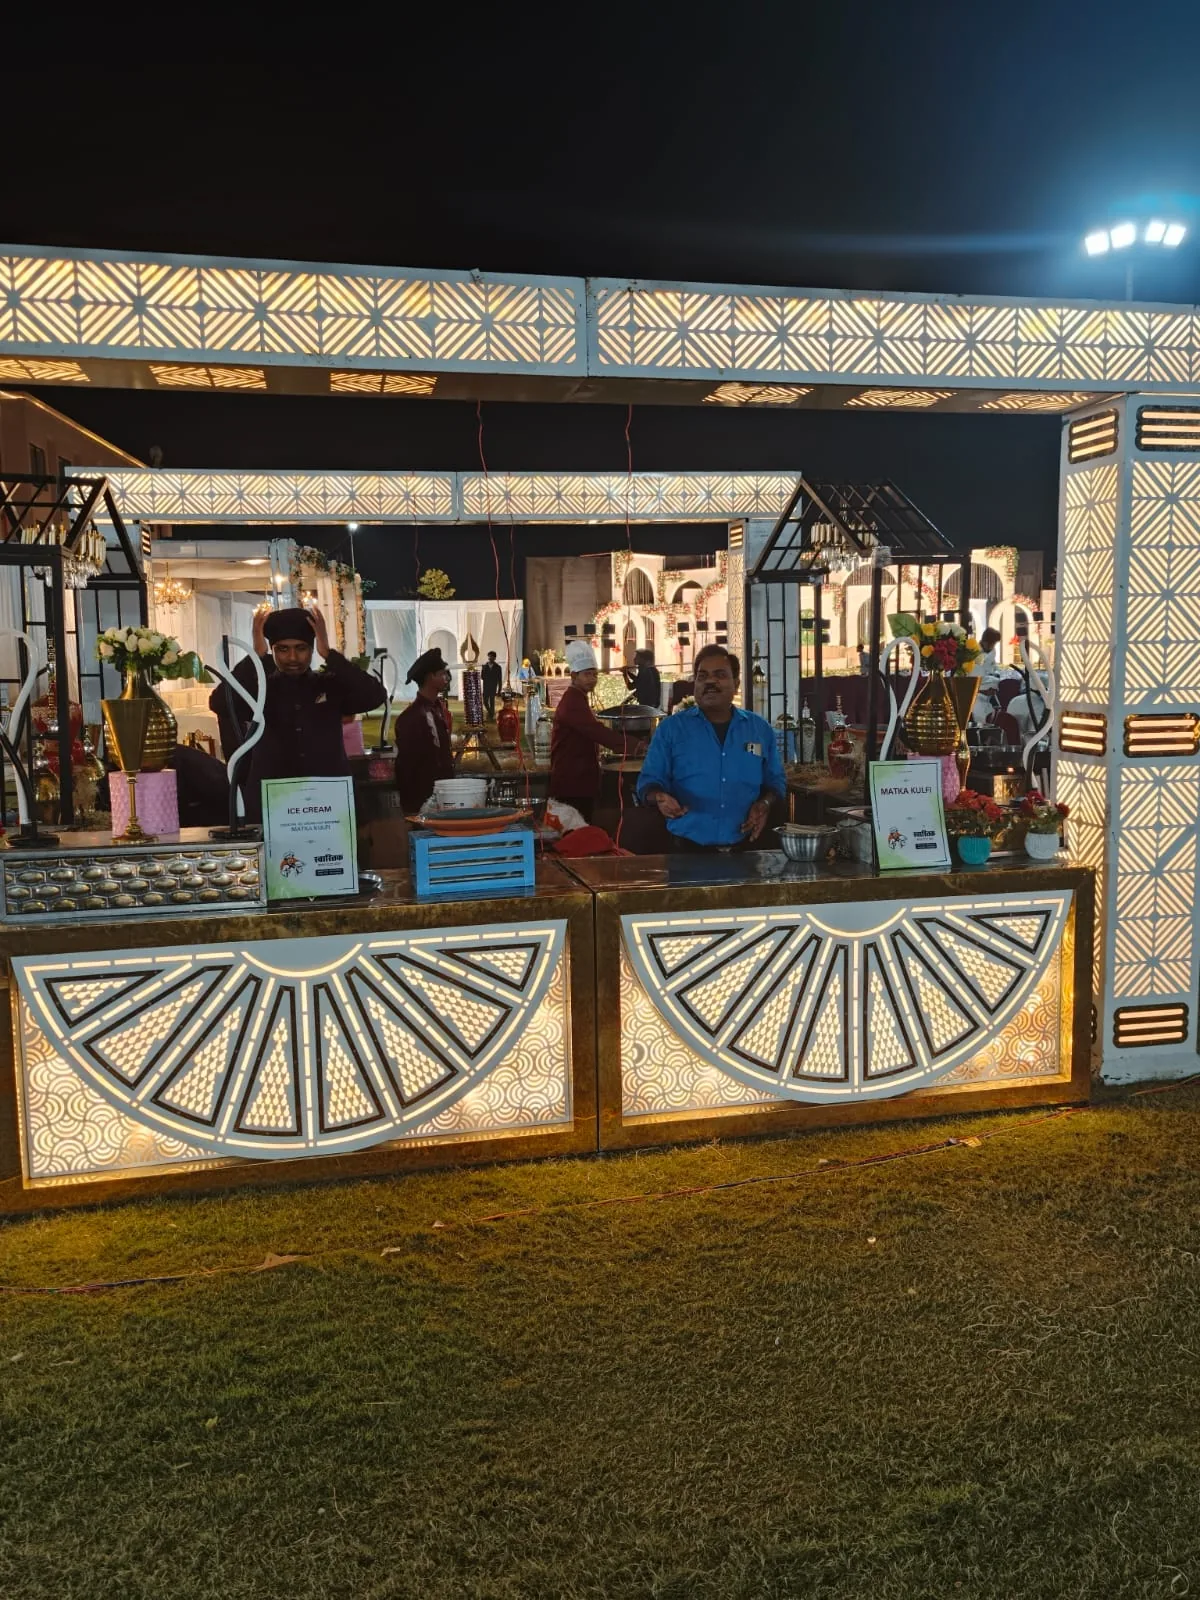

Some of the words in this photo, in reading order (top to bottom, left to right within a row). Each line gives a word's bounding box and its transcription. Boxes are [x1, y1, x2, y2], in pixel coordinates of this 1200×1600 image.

[880, 787, 909, 795] MATKA
[911, 786, 932, 794] KULFI
[287, 807, 301, 815] ICE
[302, 805, 332, 814] CREAM
